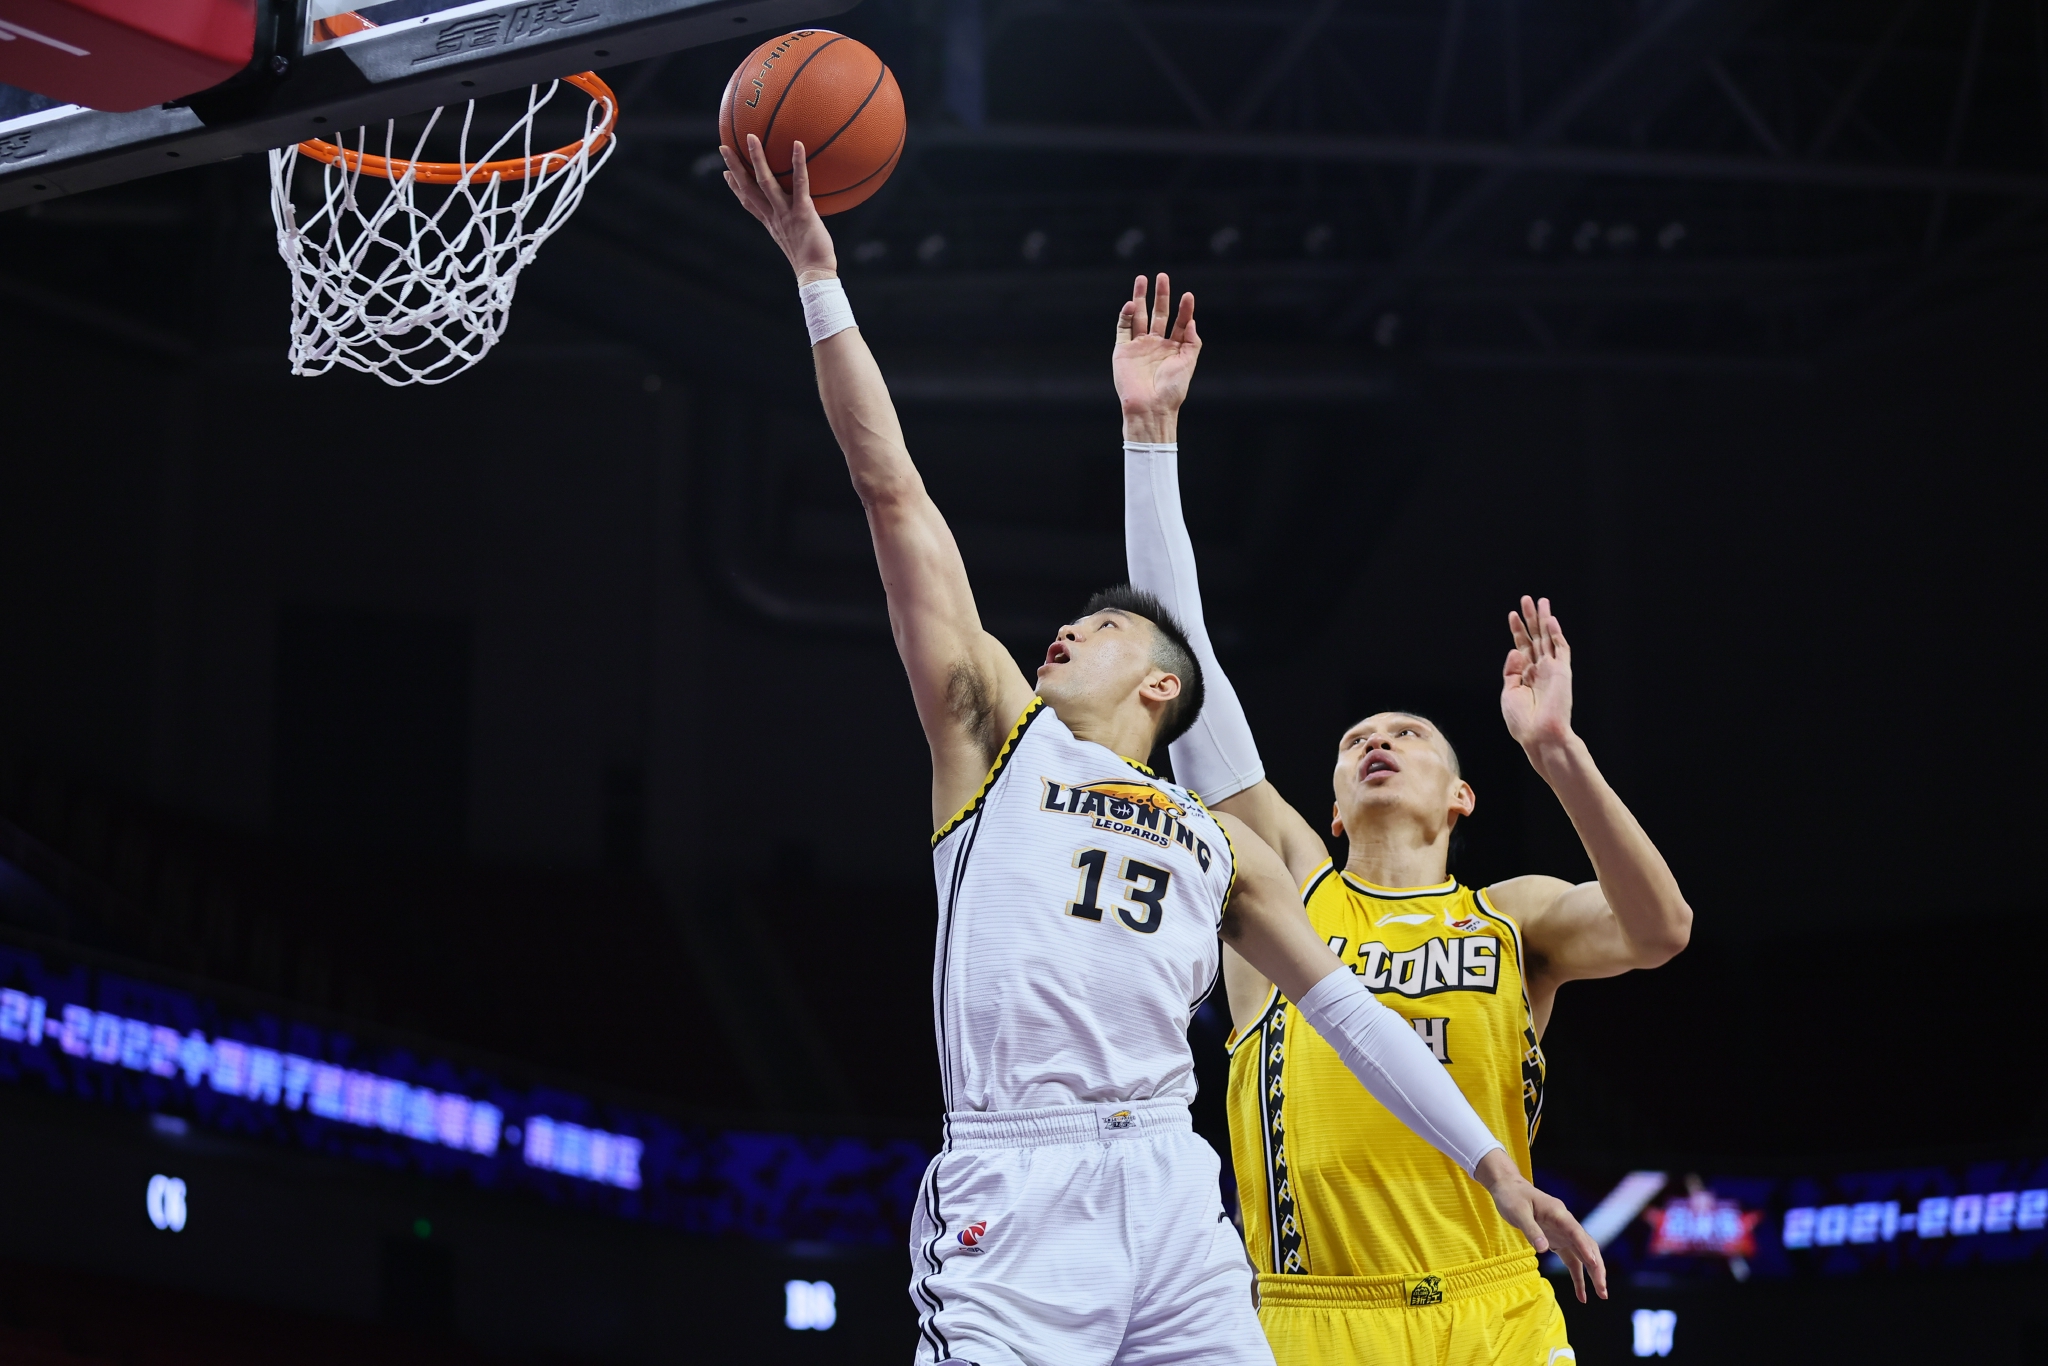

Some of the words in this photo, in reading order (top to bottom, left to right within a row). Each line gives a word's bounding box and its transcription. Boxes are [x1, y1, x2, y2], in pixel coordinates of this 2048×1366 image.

[745, 30, 816, 109] LI-NING
[1042, 779, 1212, 874] LIAONING
[1095, 818, 1169, 847] LEOPARDS
[1064, 847, 1173, 935] 13
